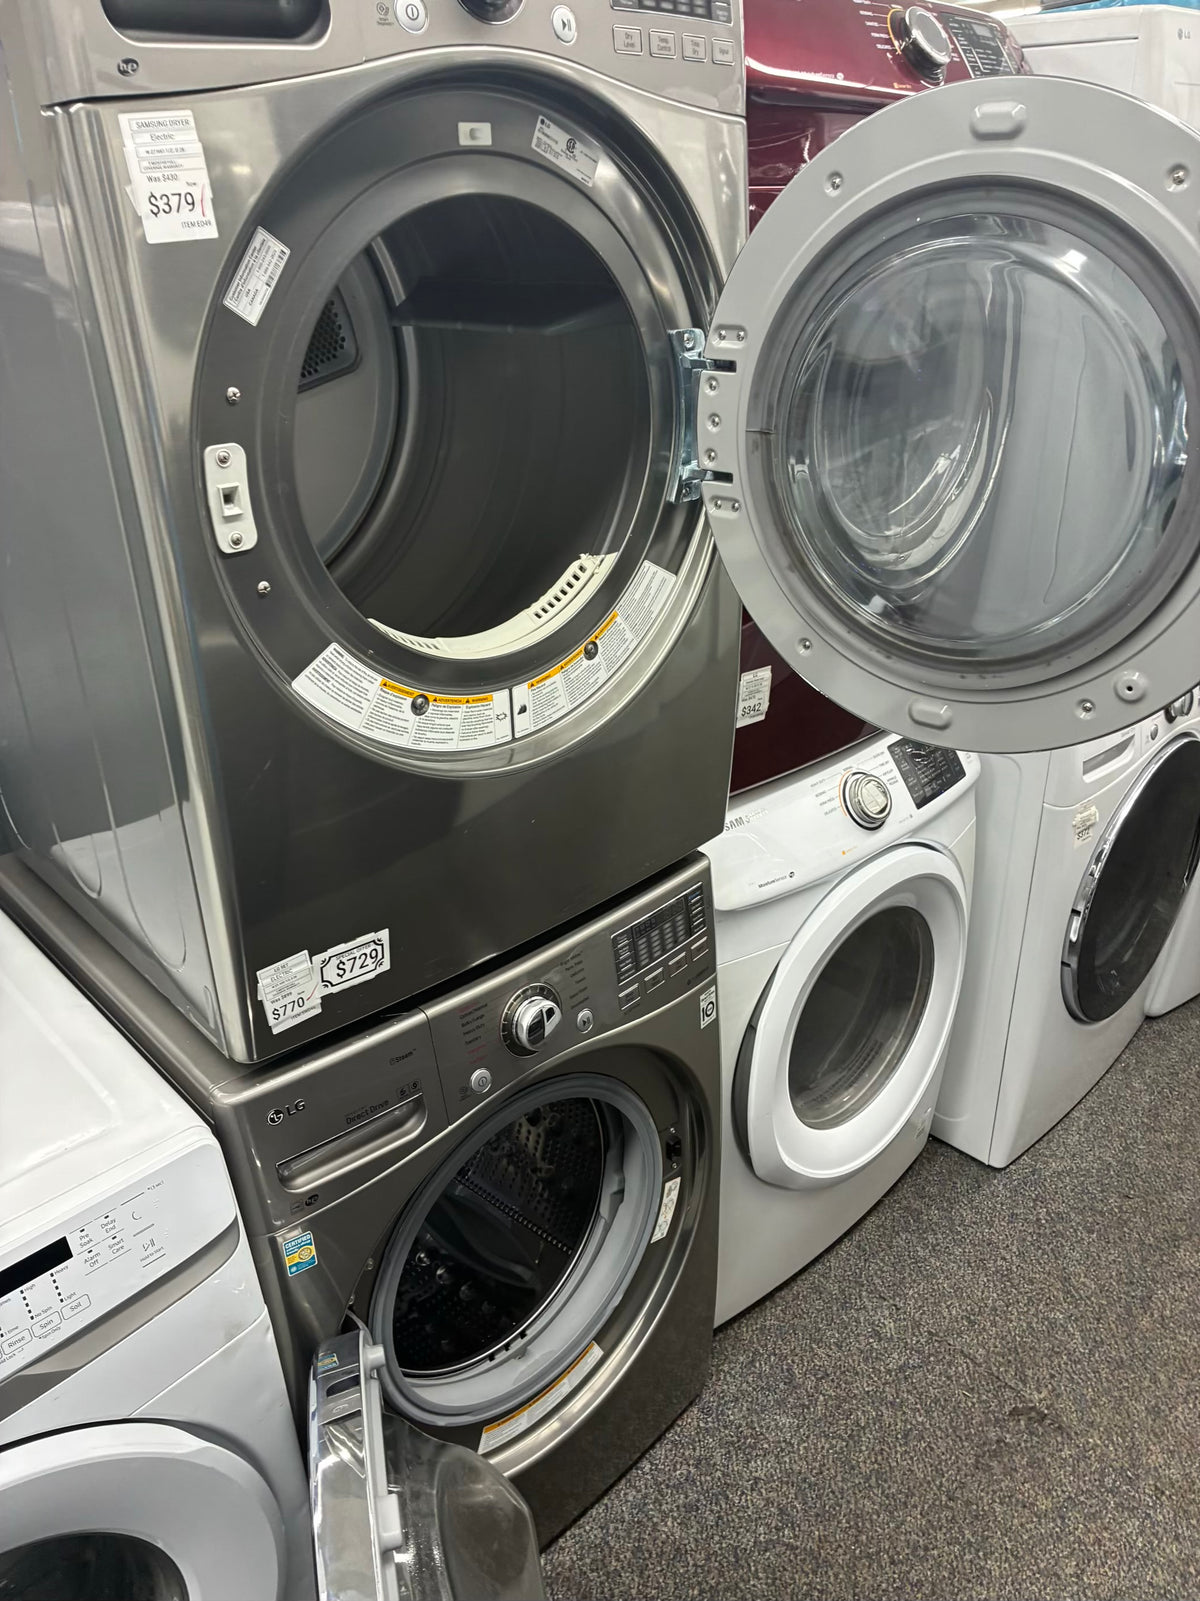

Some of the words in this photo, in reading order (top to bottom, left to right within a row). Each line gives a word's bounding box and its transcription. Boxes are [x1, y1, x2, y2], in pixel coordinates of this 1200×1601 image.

[148, 191, 195, 218] $379
[741, 702, 761, 717] $342
[336, 948, 379, 979] $729
[272, 996, 305, 1021] $770
[100, 1218, 116, 1230] Delay
[105, 1225, 117, 1234] End
[79, 1233, 90, 1242] Pre
[80, 1238, 94, 1248] Soak
[107, 1238, 125, 1250] Smart
[111, 1245, 125, 1255] Care
[84, 1252, 101, 1264] Alarm
[89, 1260, 99, 1268] Off
[24, 1283, 36, 1292] High
[63, 1291, 77, 1302] Light
[70, 1301, 82, 1312] Soil
[39, 1318, 54, 1330] Spin
[7, 1335, 26, 1349] Rinse
